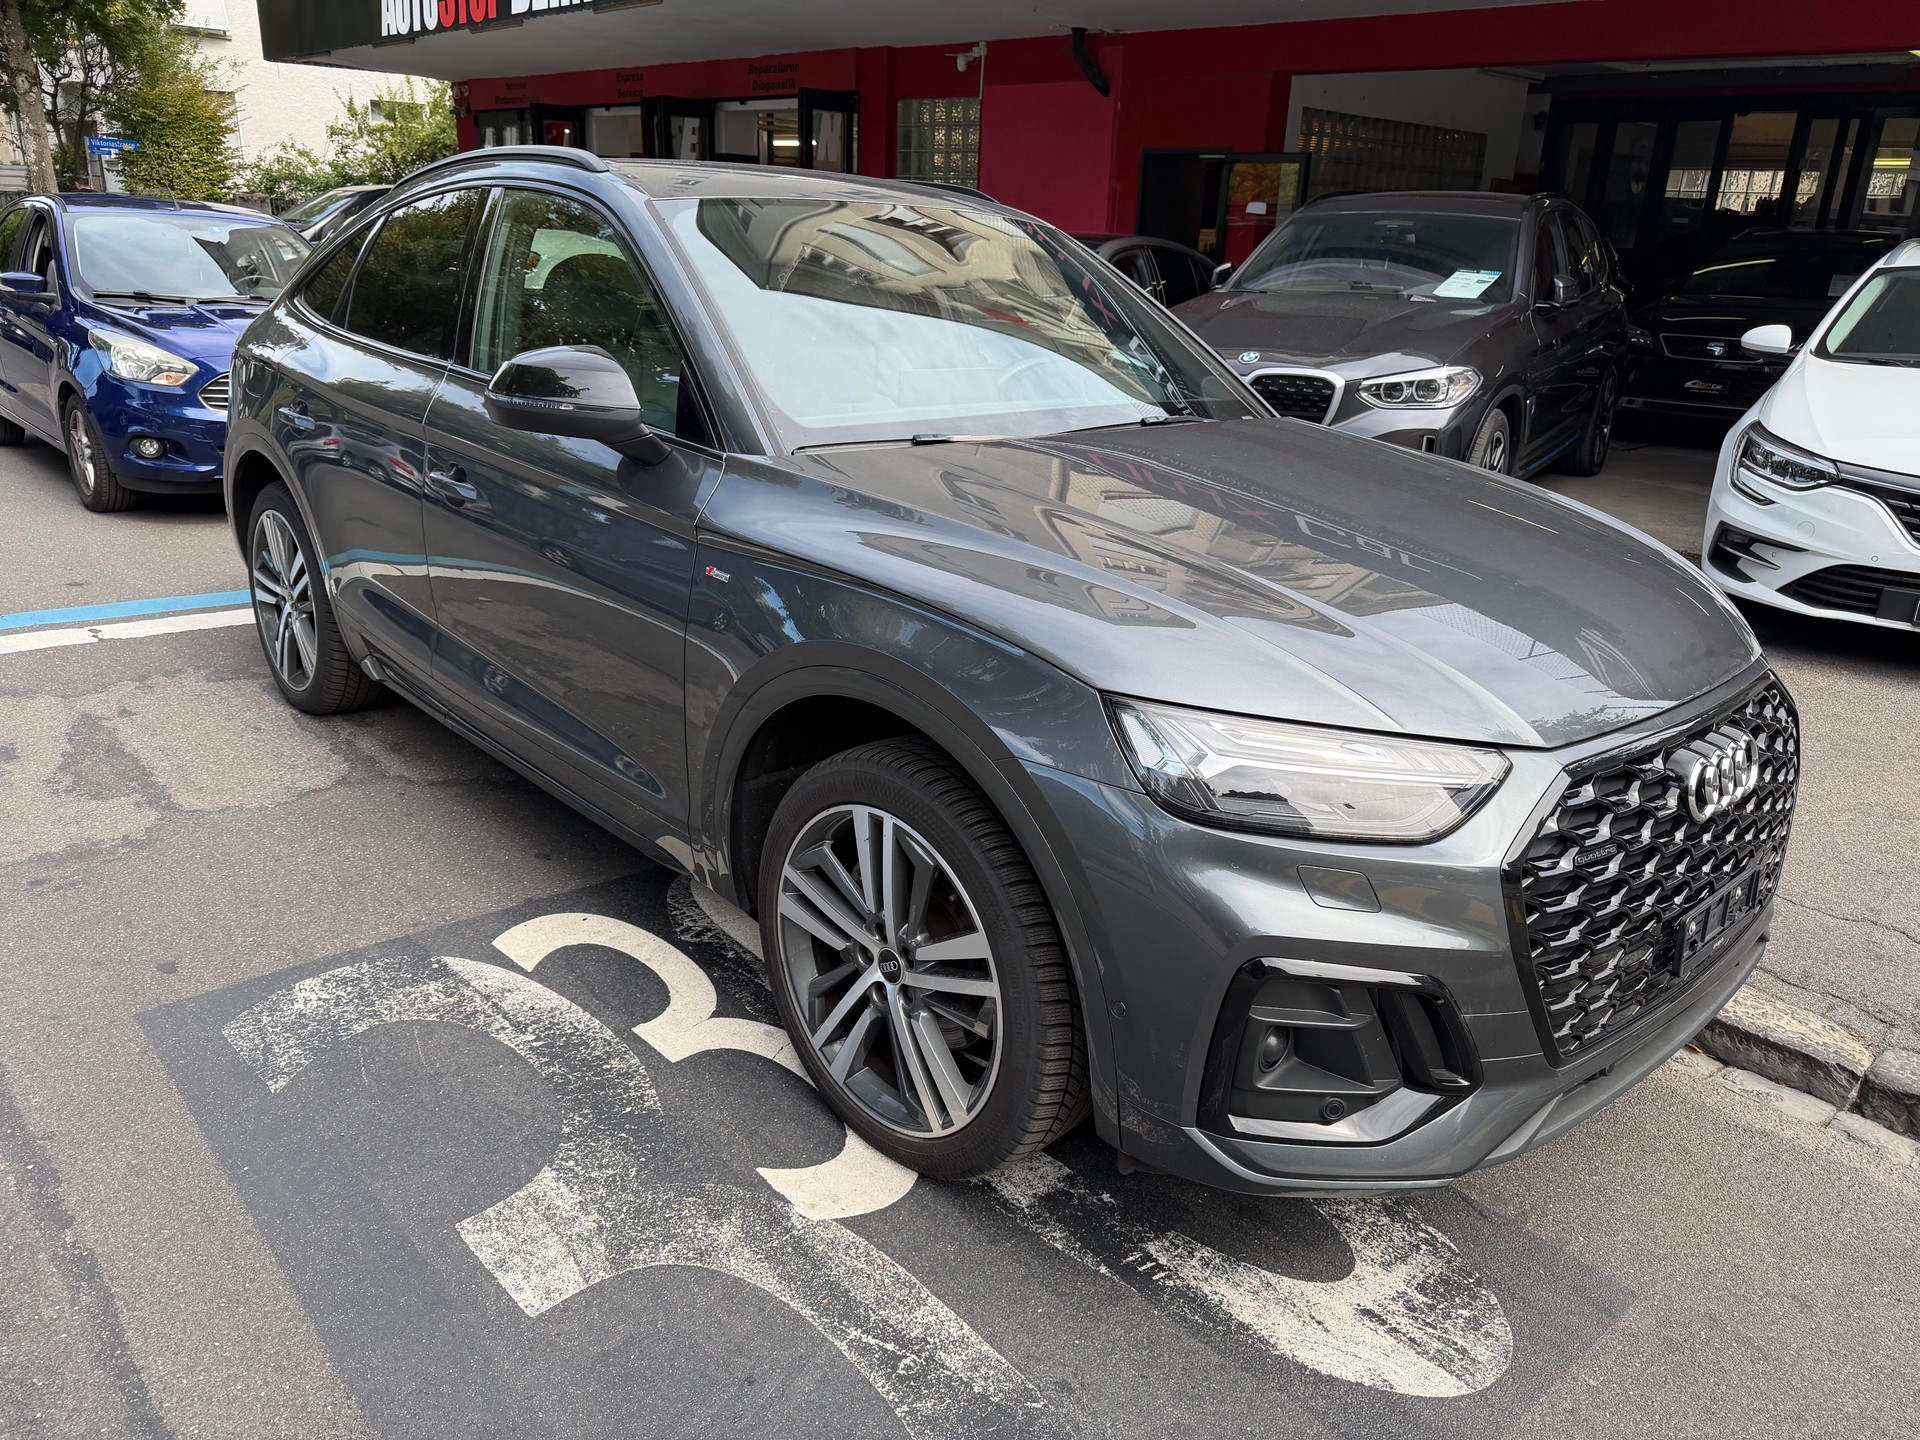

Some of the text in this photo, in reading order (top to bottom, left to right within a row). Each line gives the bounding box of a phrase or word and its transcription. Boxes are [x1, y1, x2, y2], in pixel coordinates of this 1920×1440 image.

[748, 63, 800, 76] Reparaturen
[616, 71, 644, 83] Express
[752, 79, 796, 92] Diagnostik
[617, 88, 643, 98] Service
[91, 139, 135, 147] Viktoriastrasse
[1577, 847, 1616, 863] quattro
